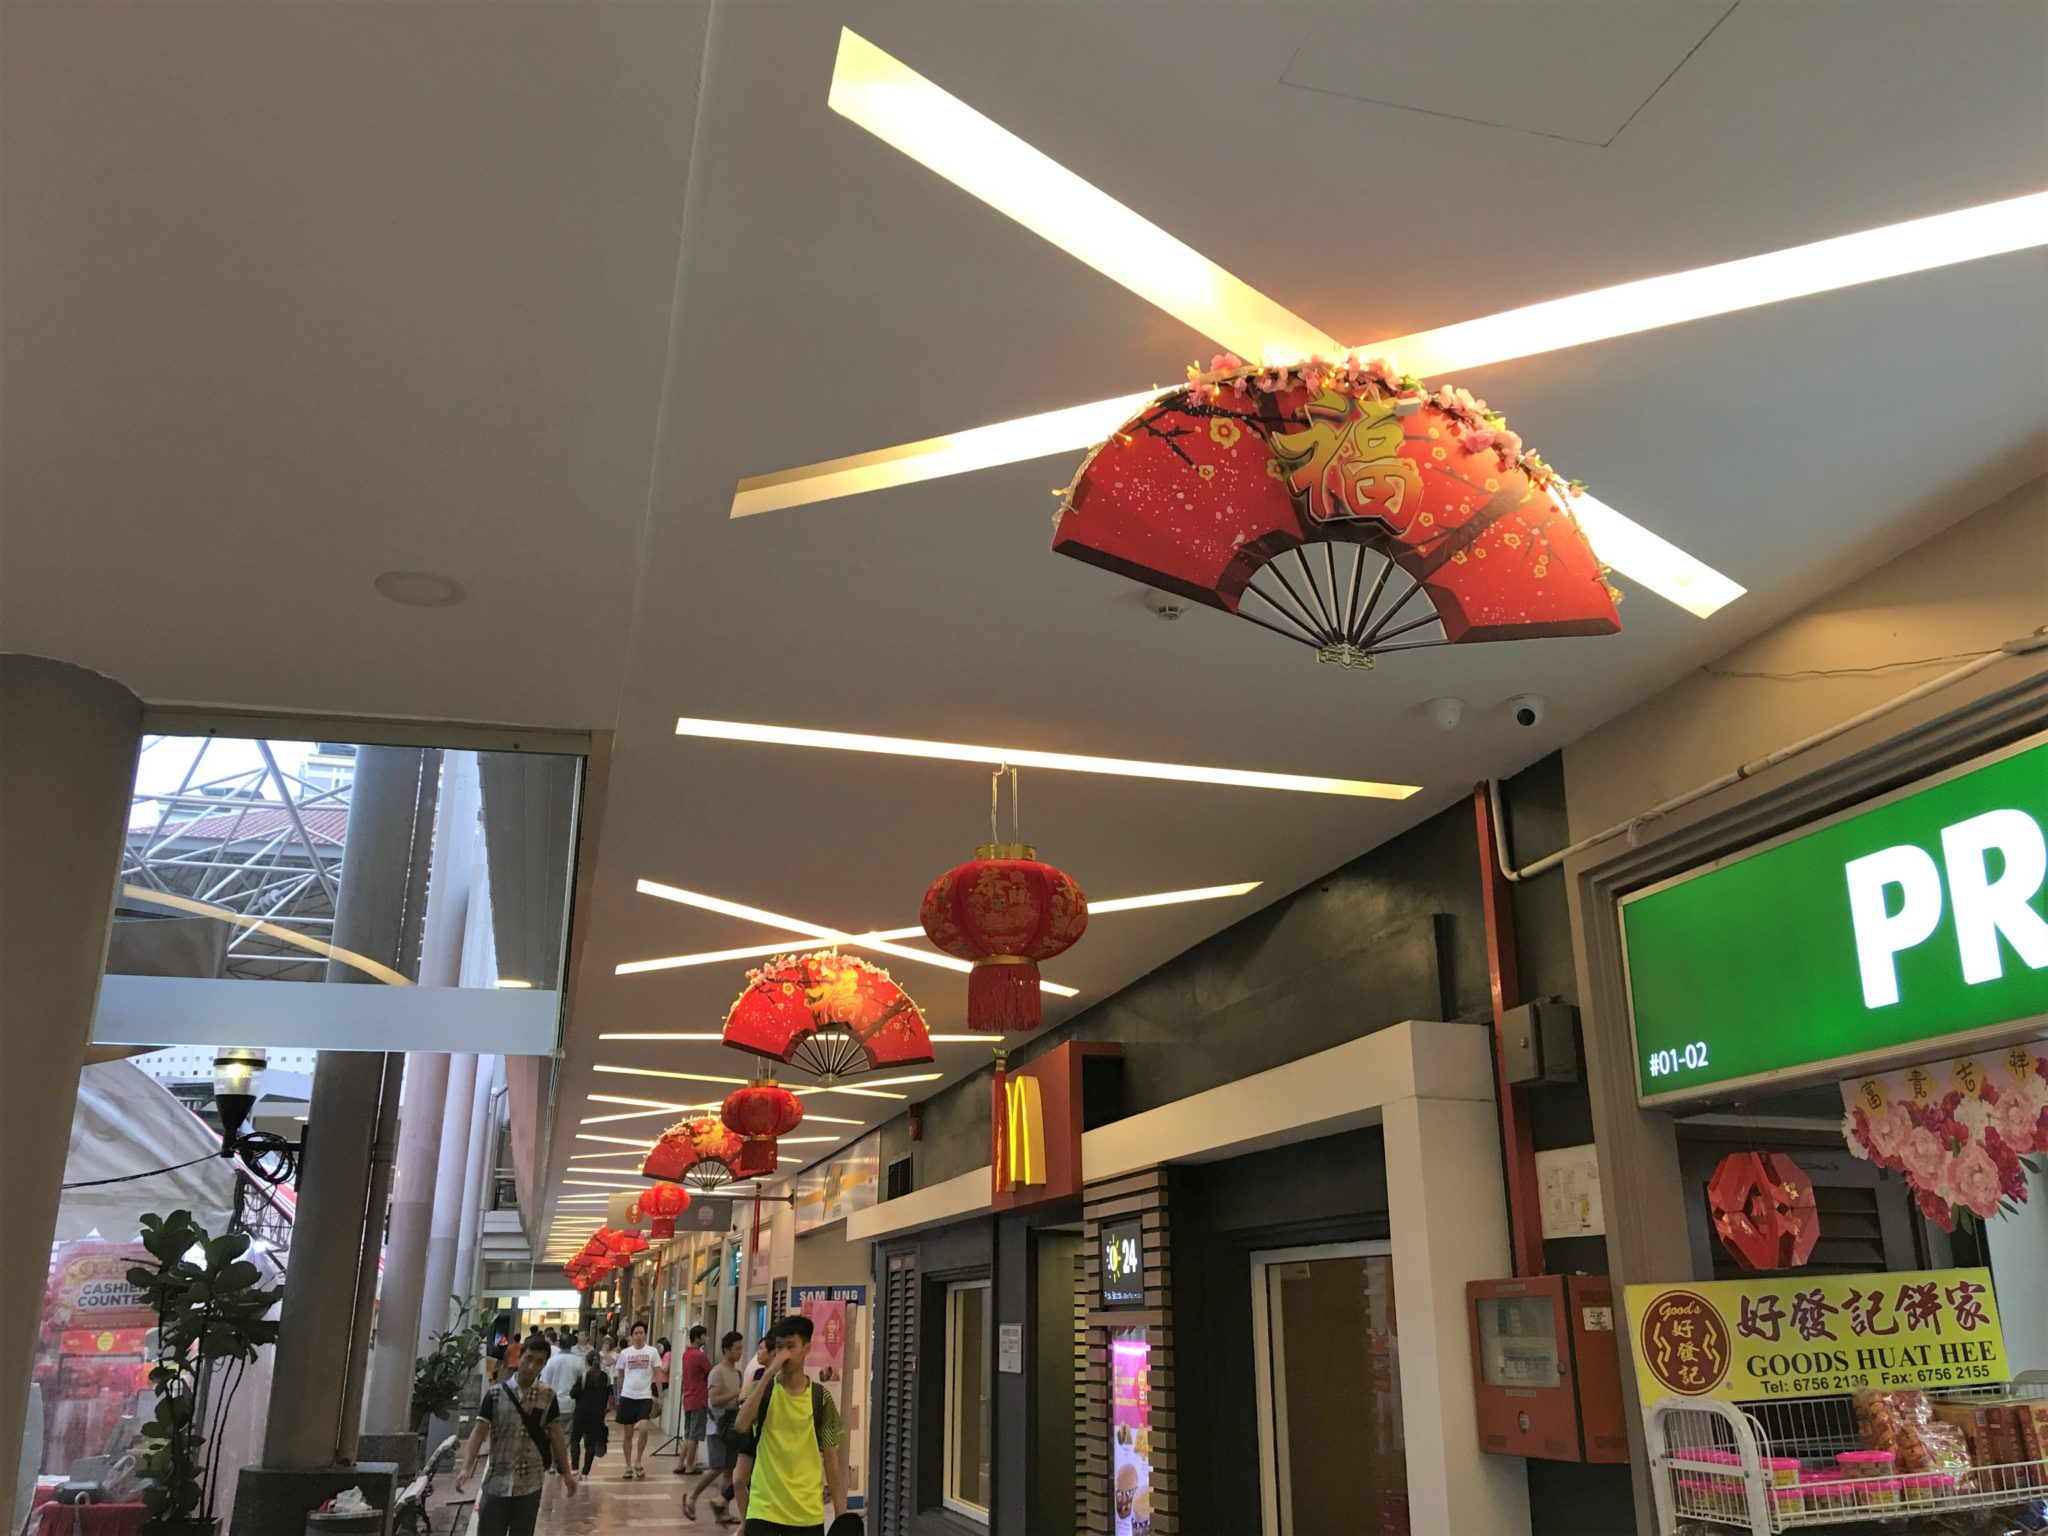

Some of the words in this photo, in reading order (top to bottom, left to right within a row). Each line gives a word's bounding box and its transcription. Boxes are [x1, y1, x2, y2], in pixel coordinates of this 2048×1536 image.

[1271, 388, 1423, 534] 福
[1845, 808, 2048, 1009] PR
[1649, 1042, 1709, 1077] #01-02
[1121, 1238, 1138, 1274] 24
[77, 1294, 147, 1307] COUNTE
[799, 1290, 858, 1301] SAMUNG
[1659, 1300, 1703, 1321] Good's
[1736, 1281, 1991, 1343] 好發記餅家
[1746, 1350, 1849, 1377] GOODS
[1857, 1344, 1931, 1370] HUAT
[1939, 1340, 1997, 1364] HEE
[1761, 1379, 1789, 1394] Tel:
[1793, 1377, 1830, 1392] 6756
[1833, 1374, 1869, 1390] 2136
[1881, 1370, 1913, 1386] Fax:
[1917, 1367, 1952, 1381] 6756
[1957, 1365, 1990, 1379] 2155
